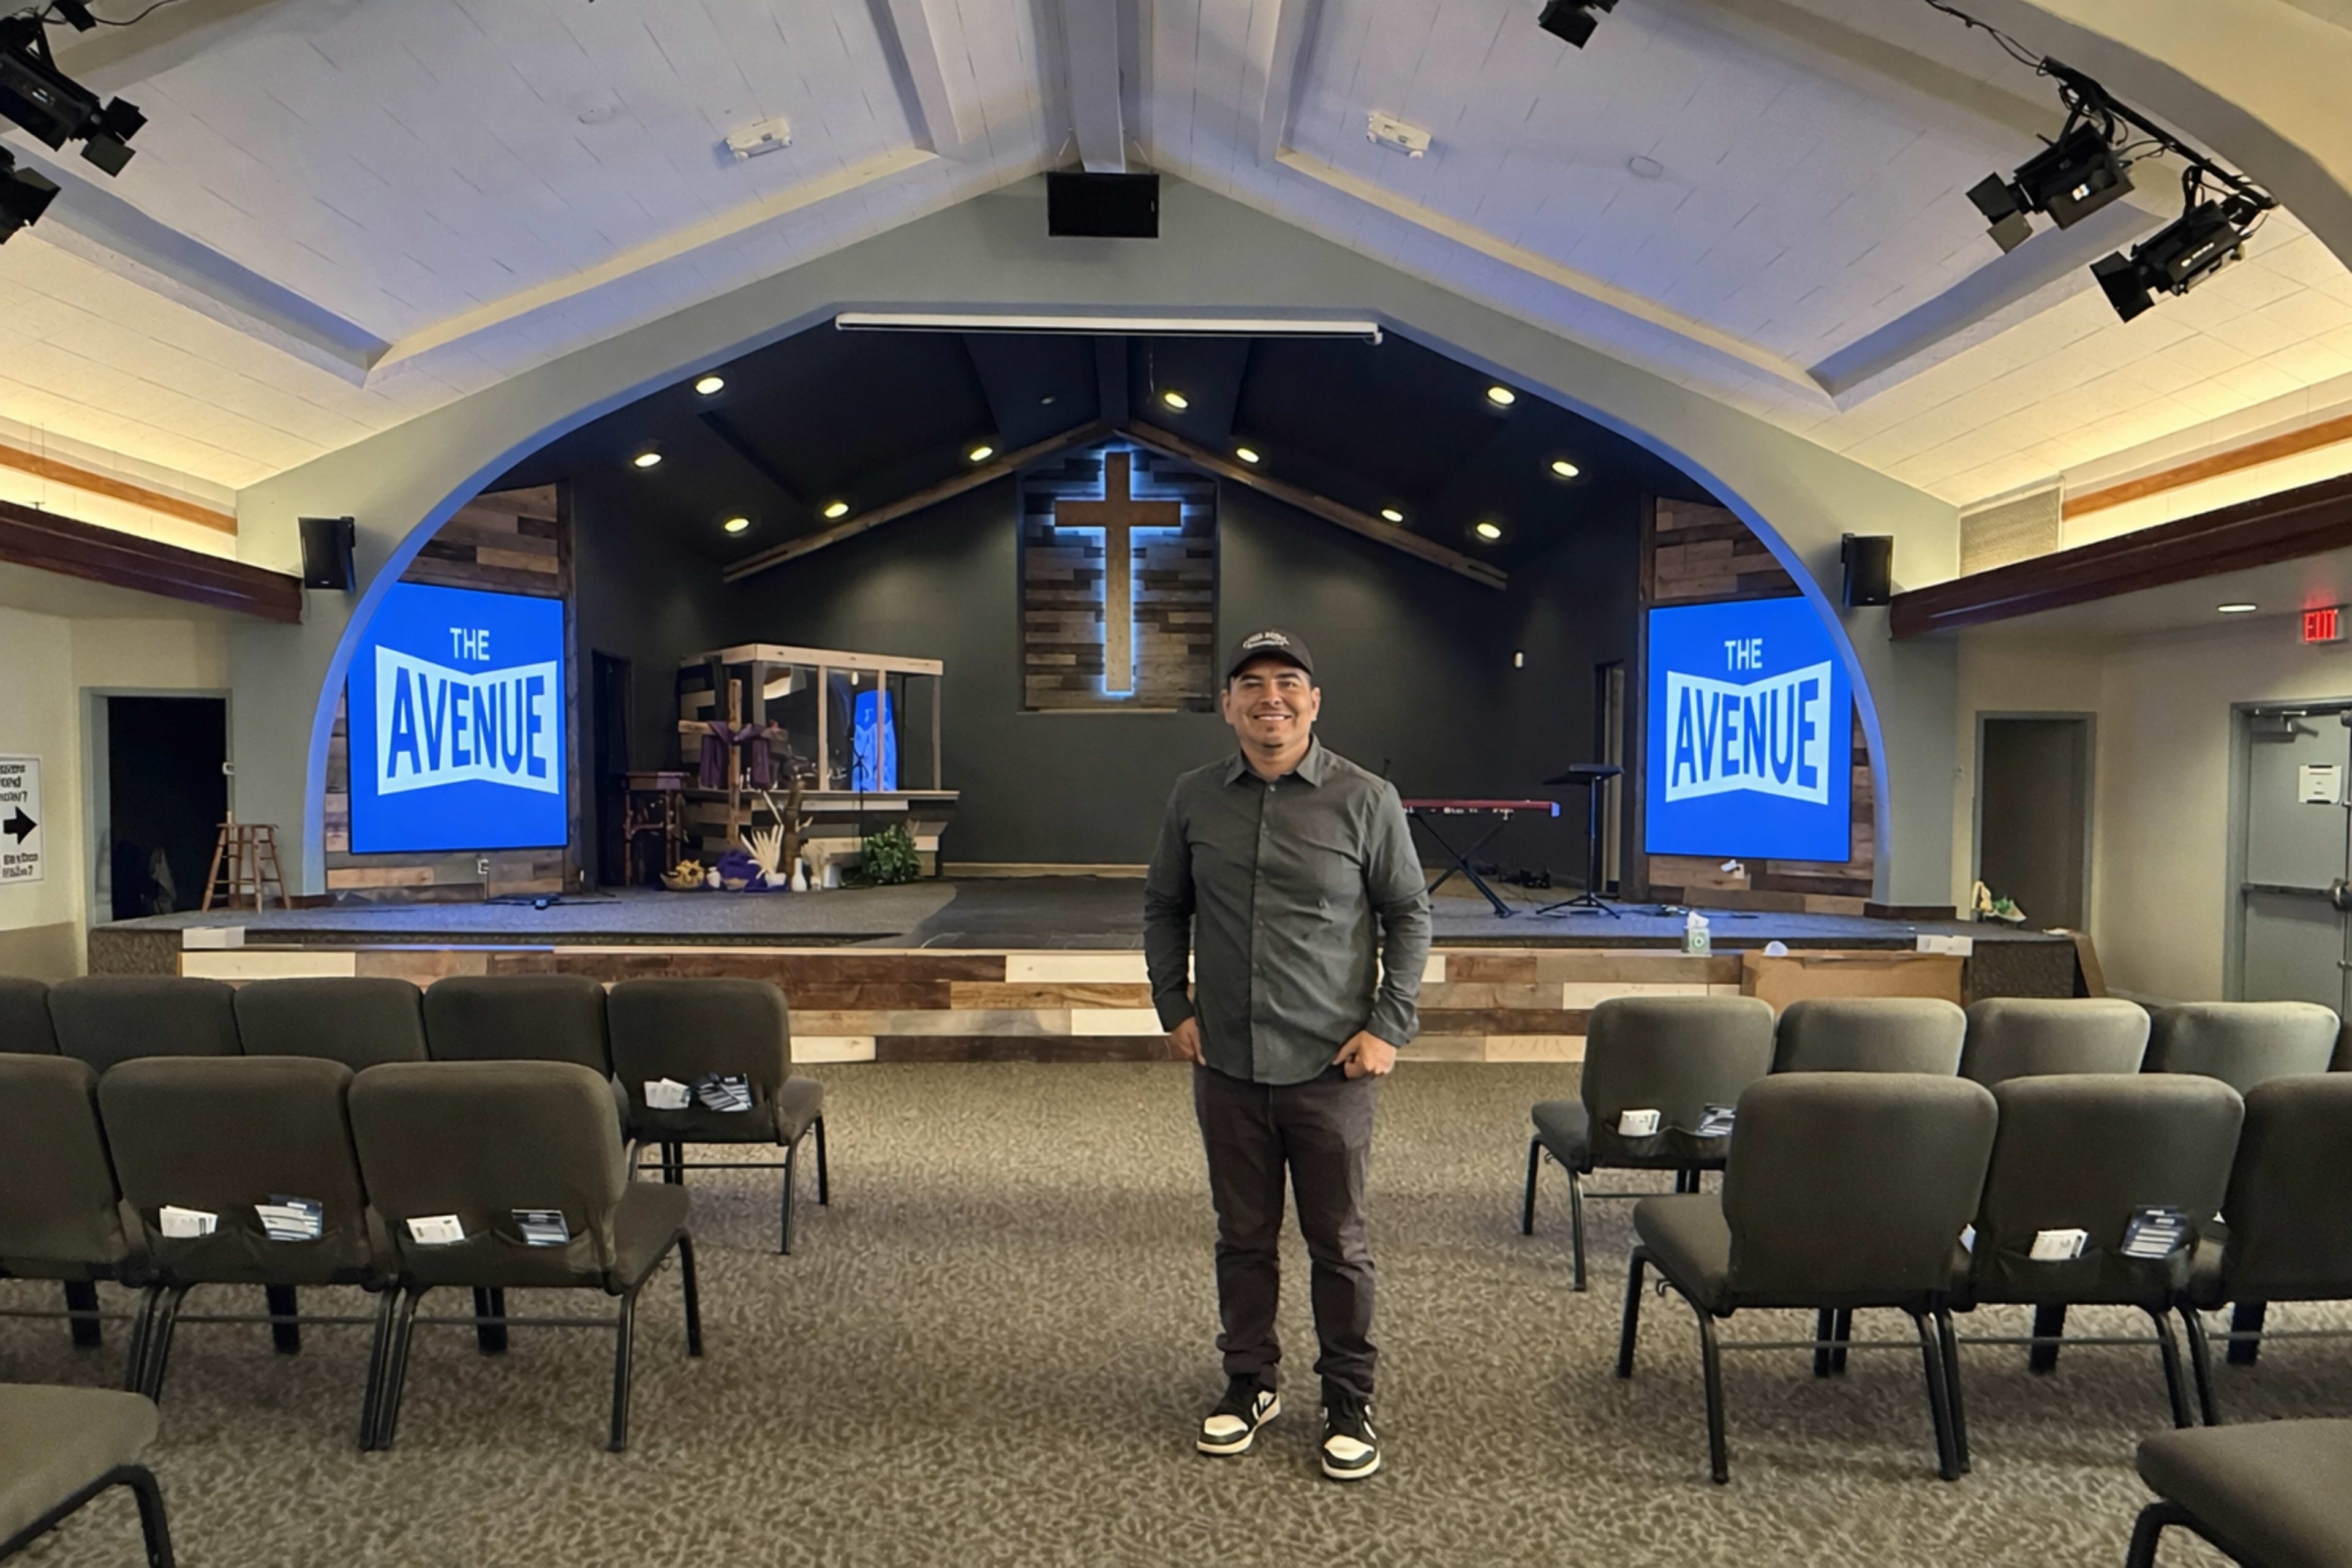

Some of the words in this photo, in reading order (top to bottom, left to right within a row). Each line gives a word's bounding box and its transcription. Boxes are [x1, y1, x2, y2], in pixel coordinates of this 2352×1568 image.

[2304, 609, 2339, 641] EIT
[449, 627, 490, 660] THE
[1724, 638, 1763, 671] THE
[387, 666, 547, 780] AVENUE
[1671, 677, 1819, 790] AVENUE
